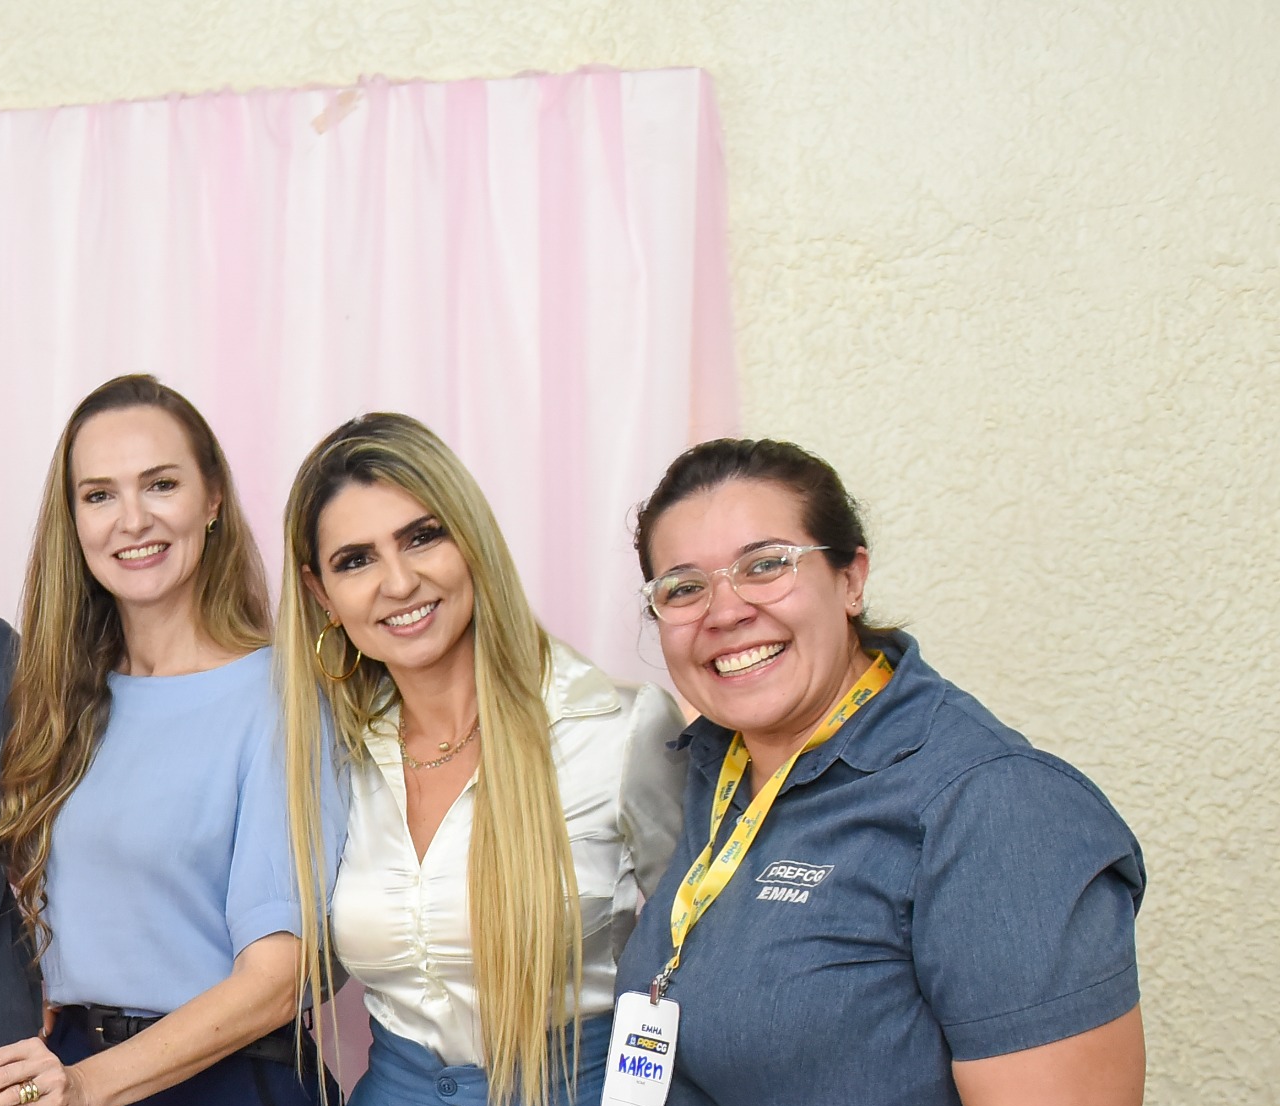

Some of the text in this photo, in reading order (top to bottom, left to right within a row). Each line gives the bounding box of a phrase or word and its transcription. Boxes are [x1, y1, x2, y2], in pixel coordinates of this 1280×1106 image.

[767, 865, 826, 883] PREFCG
[756, 886, 810, 904] EMHA
[641, 1024, 663, 1036] EMHA
[637, 1037, 668, 1053] PREFCG
